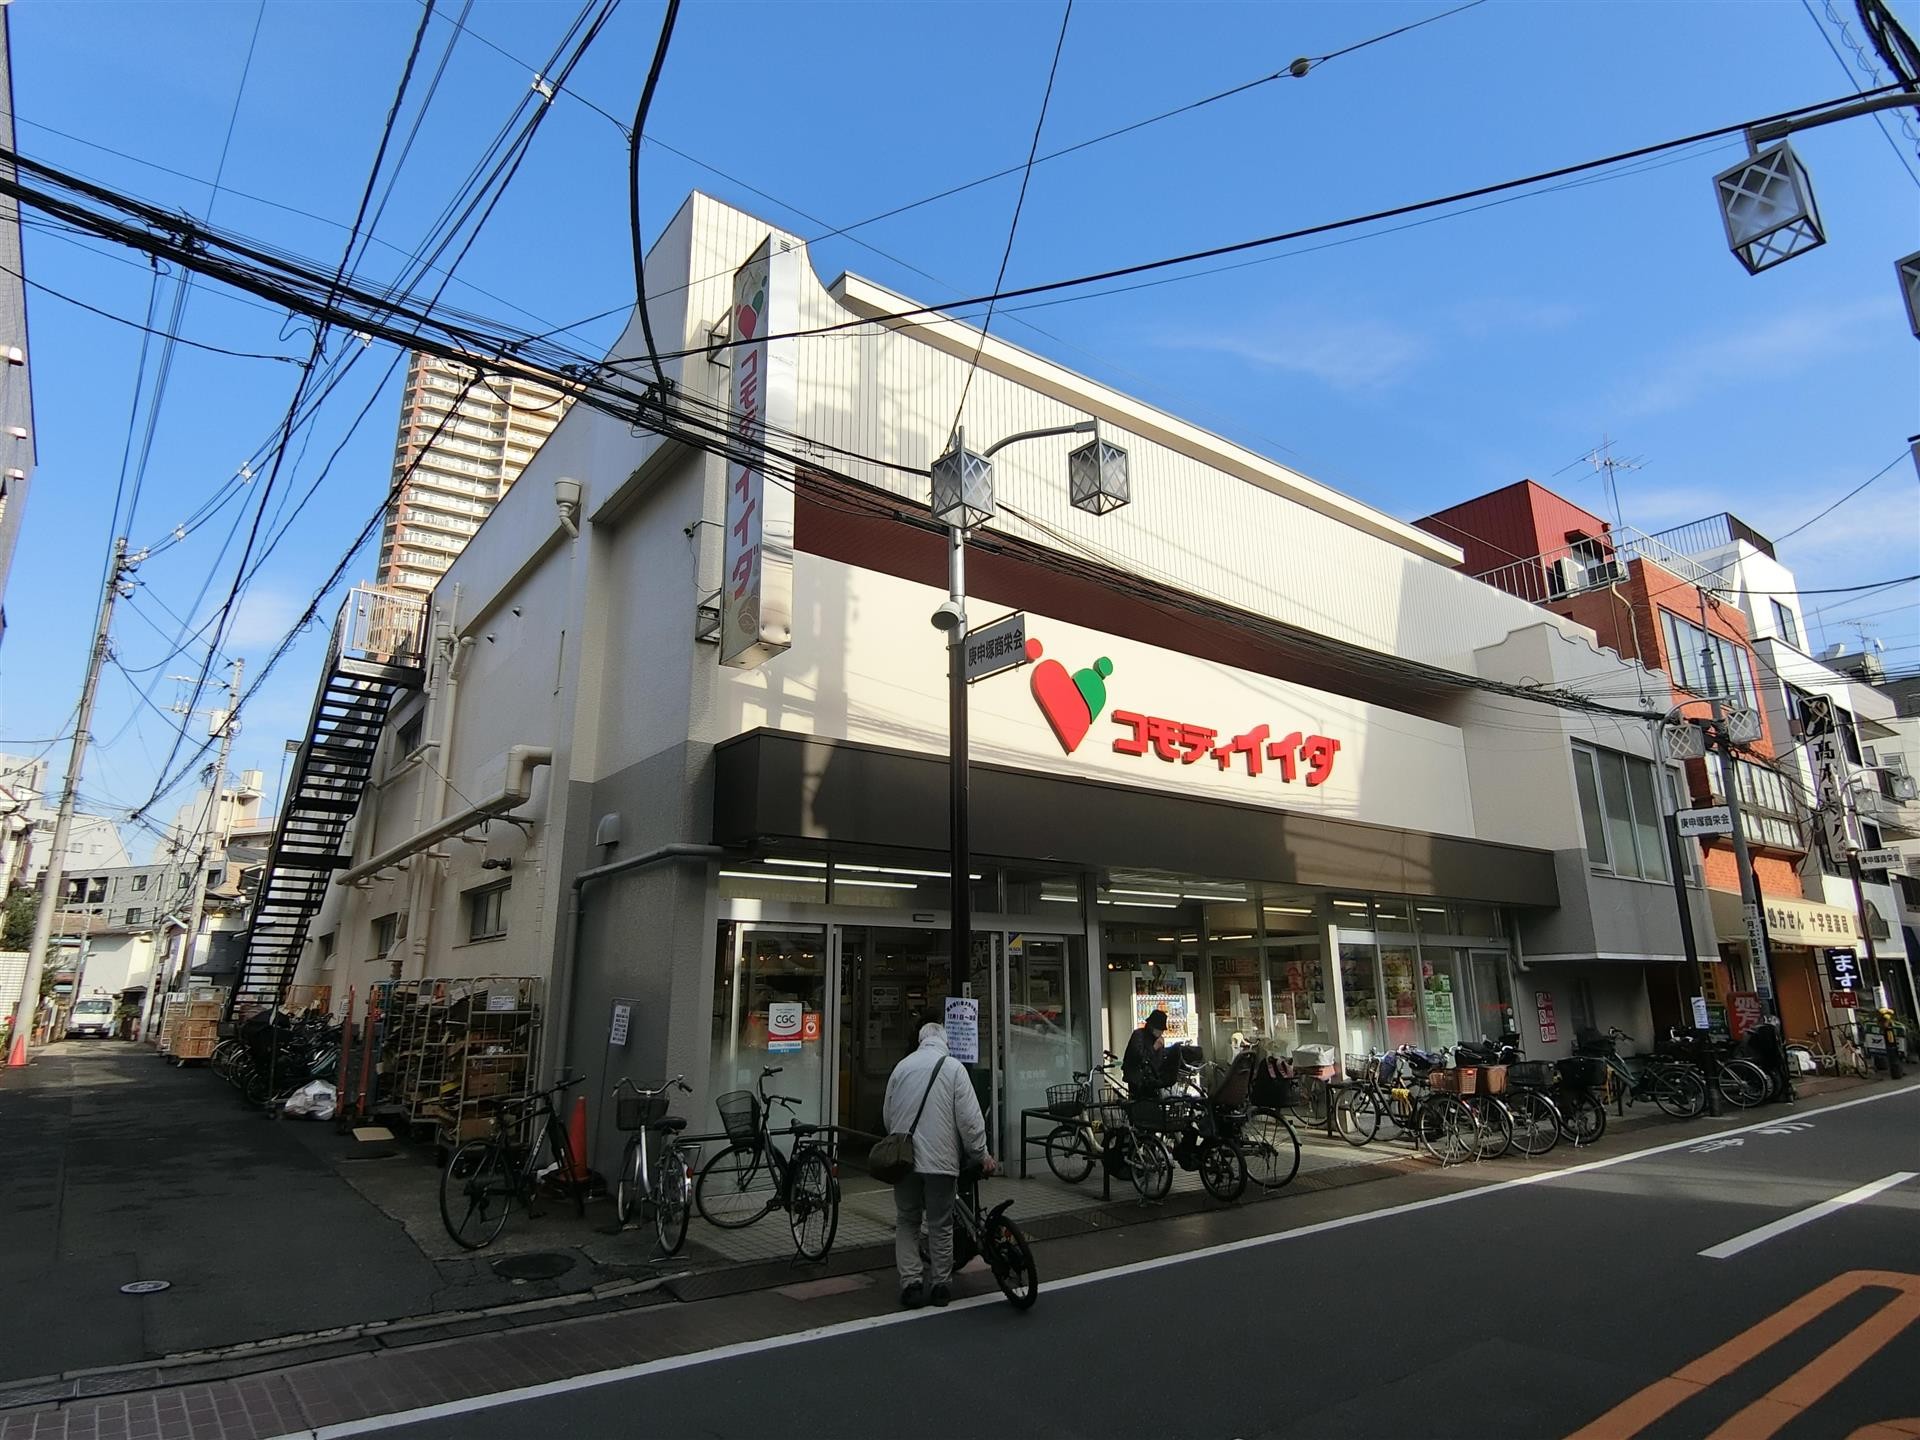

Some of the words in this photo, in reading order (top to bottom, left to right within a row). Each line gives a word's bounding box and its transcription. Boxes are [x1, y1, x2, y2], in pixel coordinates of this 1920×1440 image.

[968, 628, 1023, 667] 庚申塚商栄会
[1111, 709, 1341, 788] コモディイイダ
[1680, 813, 1730, 829] 庚申塚商栄会
[1766, 907, 1804, 930] 処方せん
[775, 1014, 796, 1024] CGC
